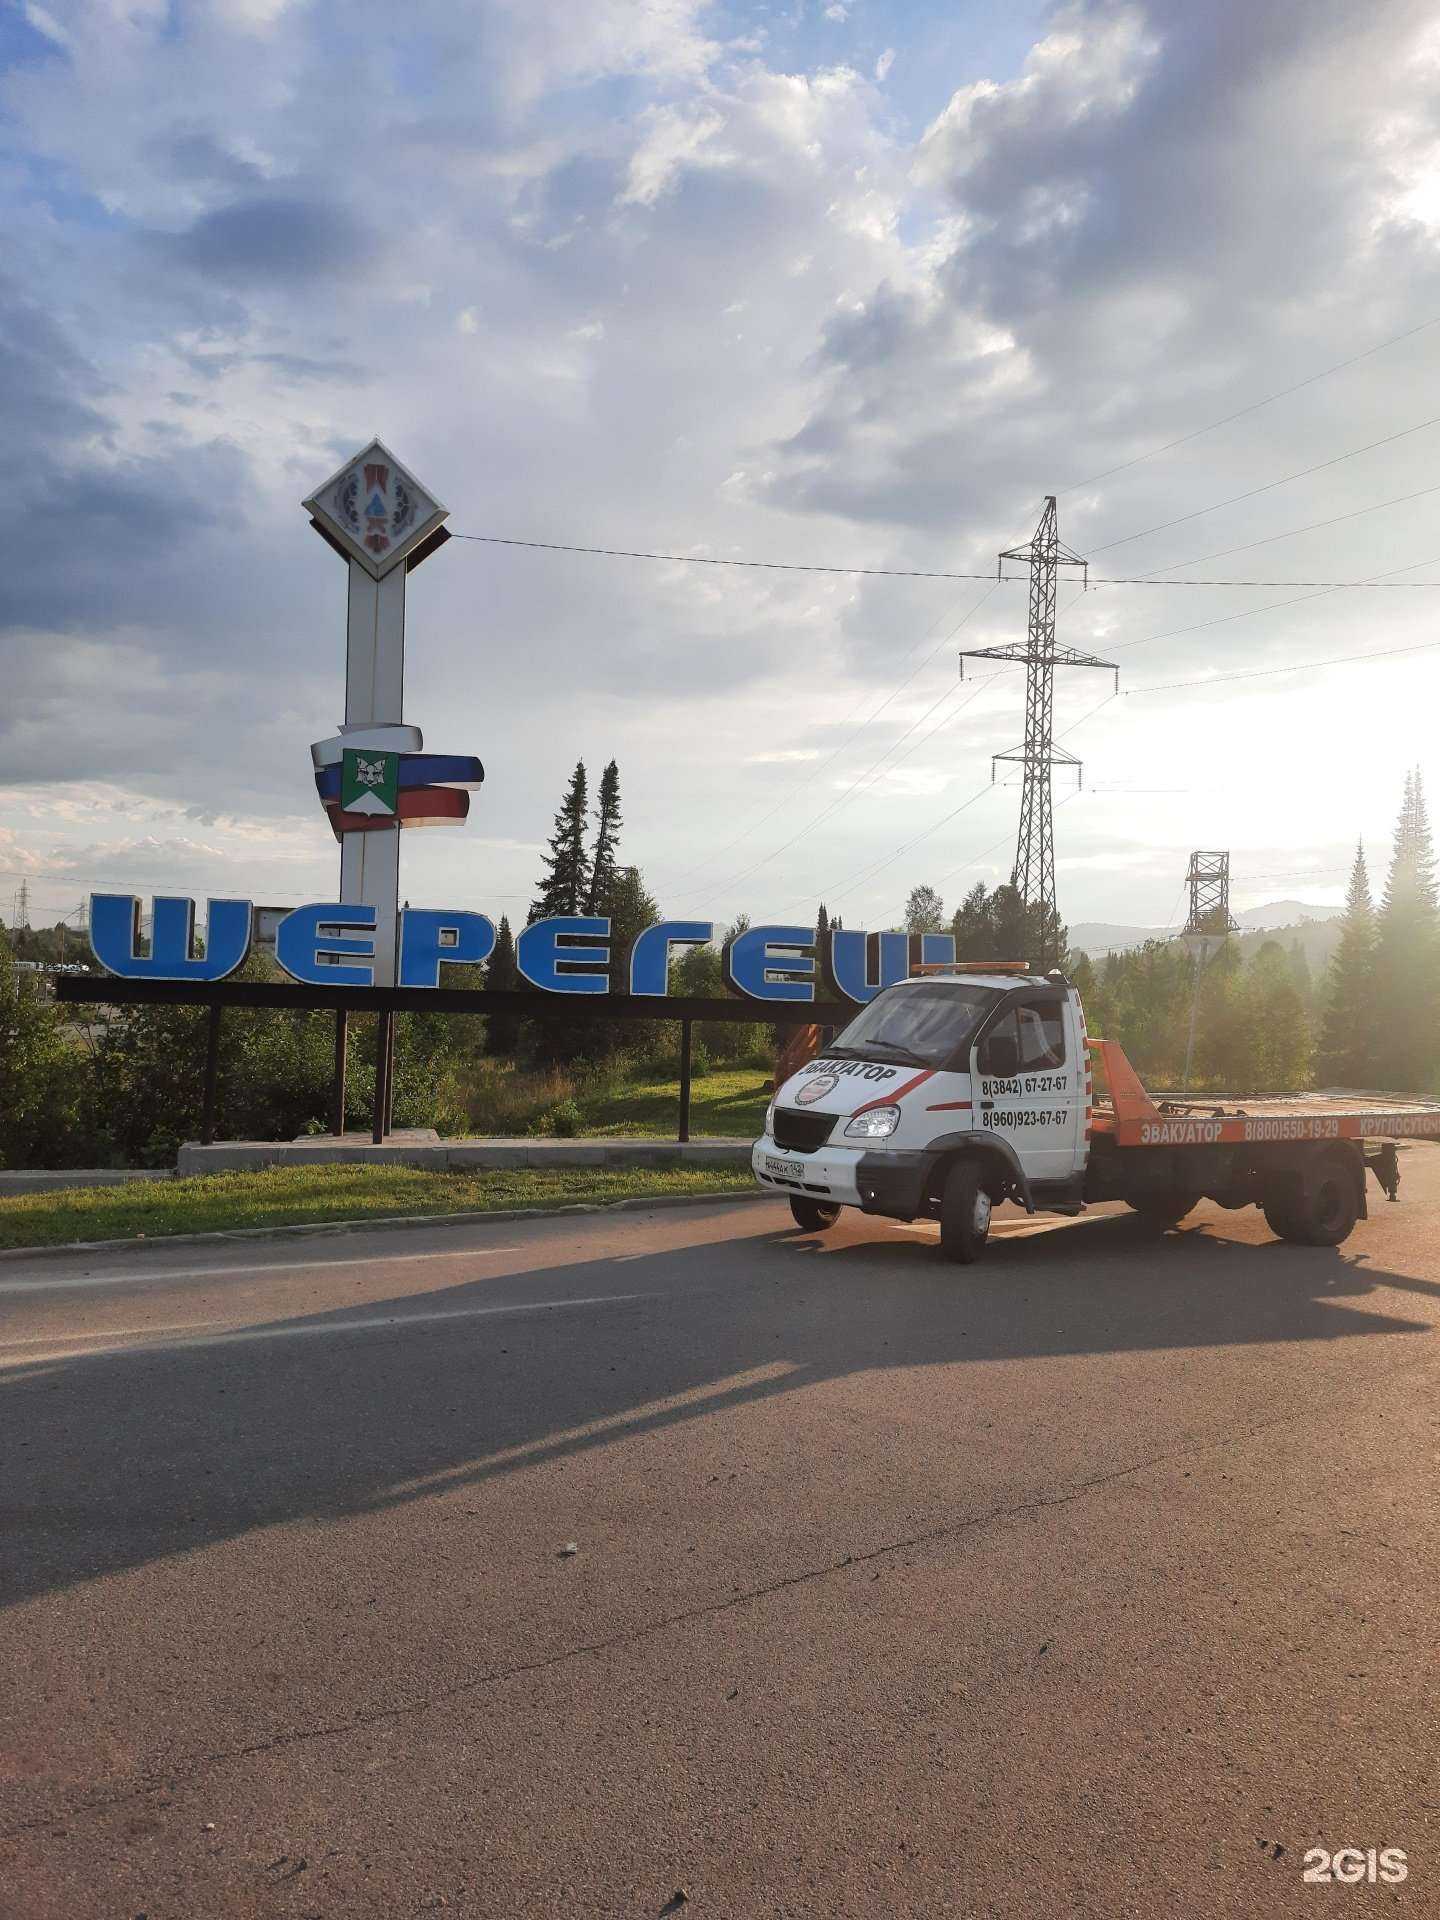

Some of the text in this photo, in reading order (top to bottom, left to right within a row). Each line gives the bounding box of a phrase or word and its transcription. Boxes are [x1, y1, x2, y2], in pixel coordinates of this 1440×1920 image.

[982, 1076, 1067, 1098] 8(3842) 67-27-67
[982, 1110, 1067, 1130] 8(960)923-67-67
[1141, 1123, 1223, 1144] ЭВАКУАТОР
